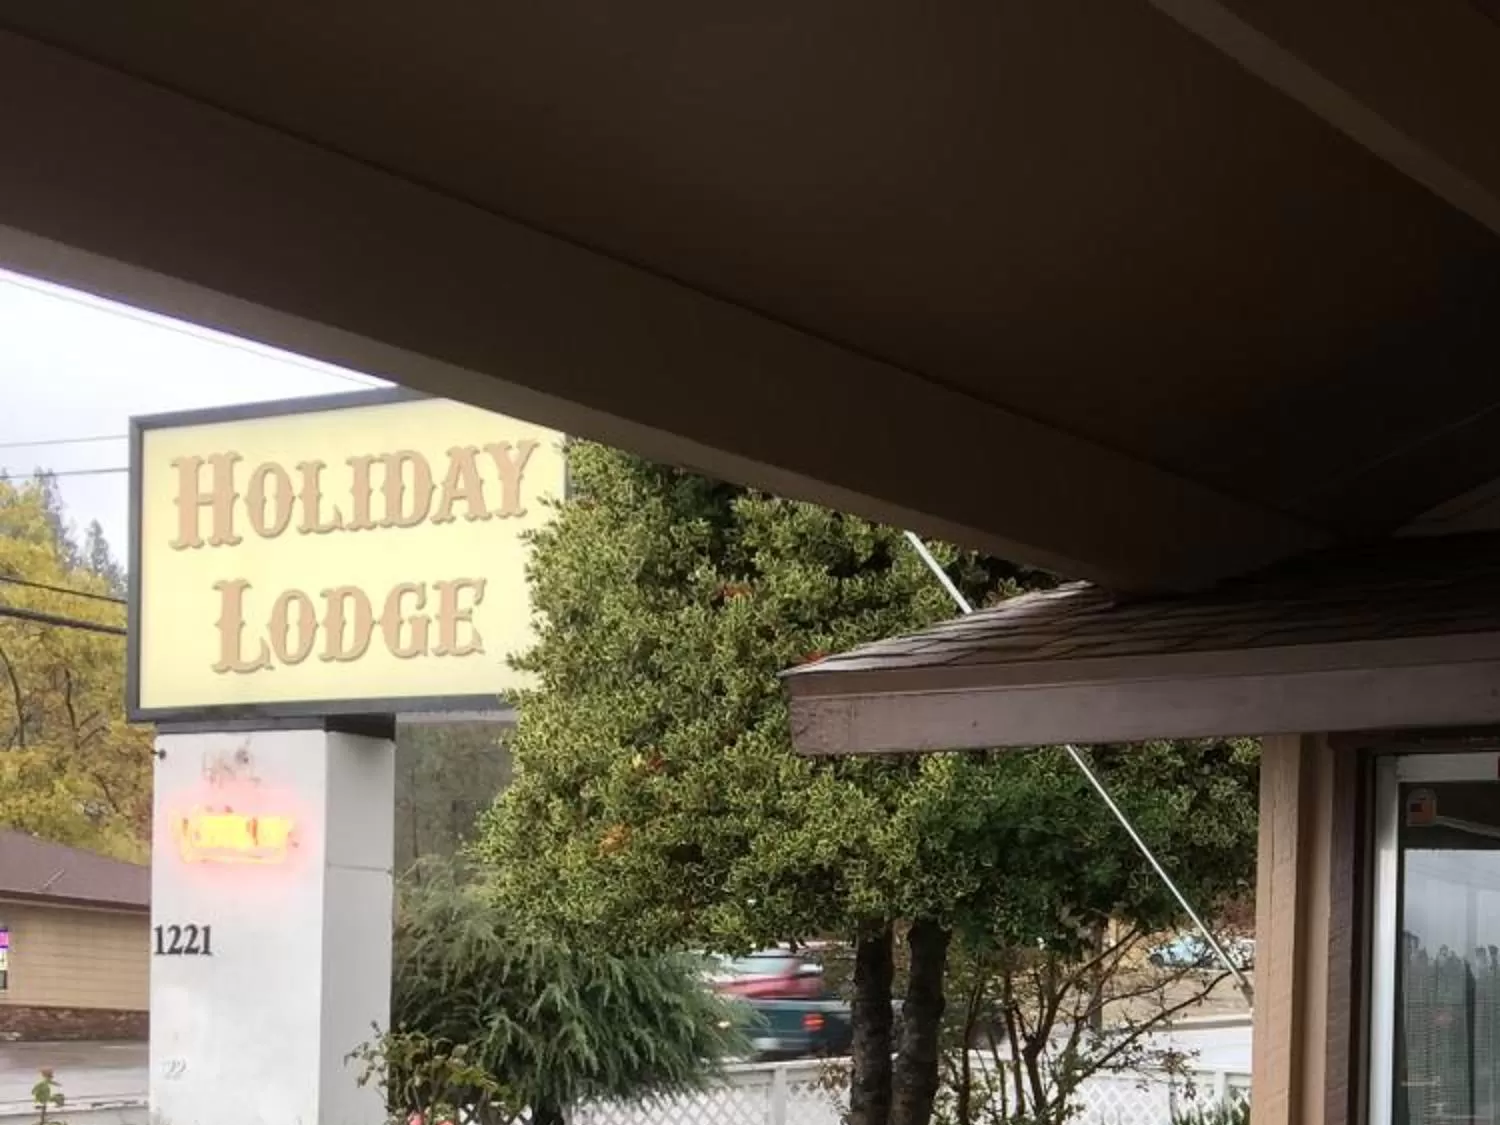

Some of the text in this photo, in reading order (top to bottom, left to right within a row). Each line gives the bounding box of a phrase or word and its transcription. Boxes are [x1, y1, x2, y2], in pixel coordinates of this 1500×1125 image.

[169, 438, 540, 551] HOLIDAY
[211, 577, 487, 675] LODGE
[154, 923, 213, 957] 1221
